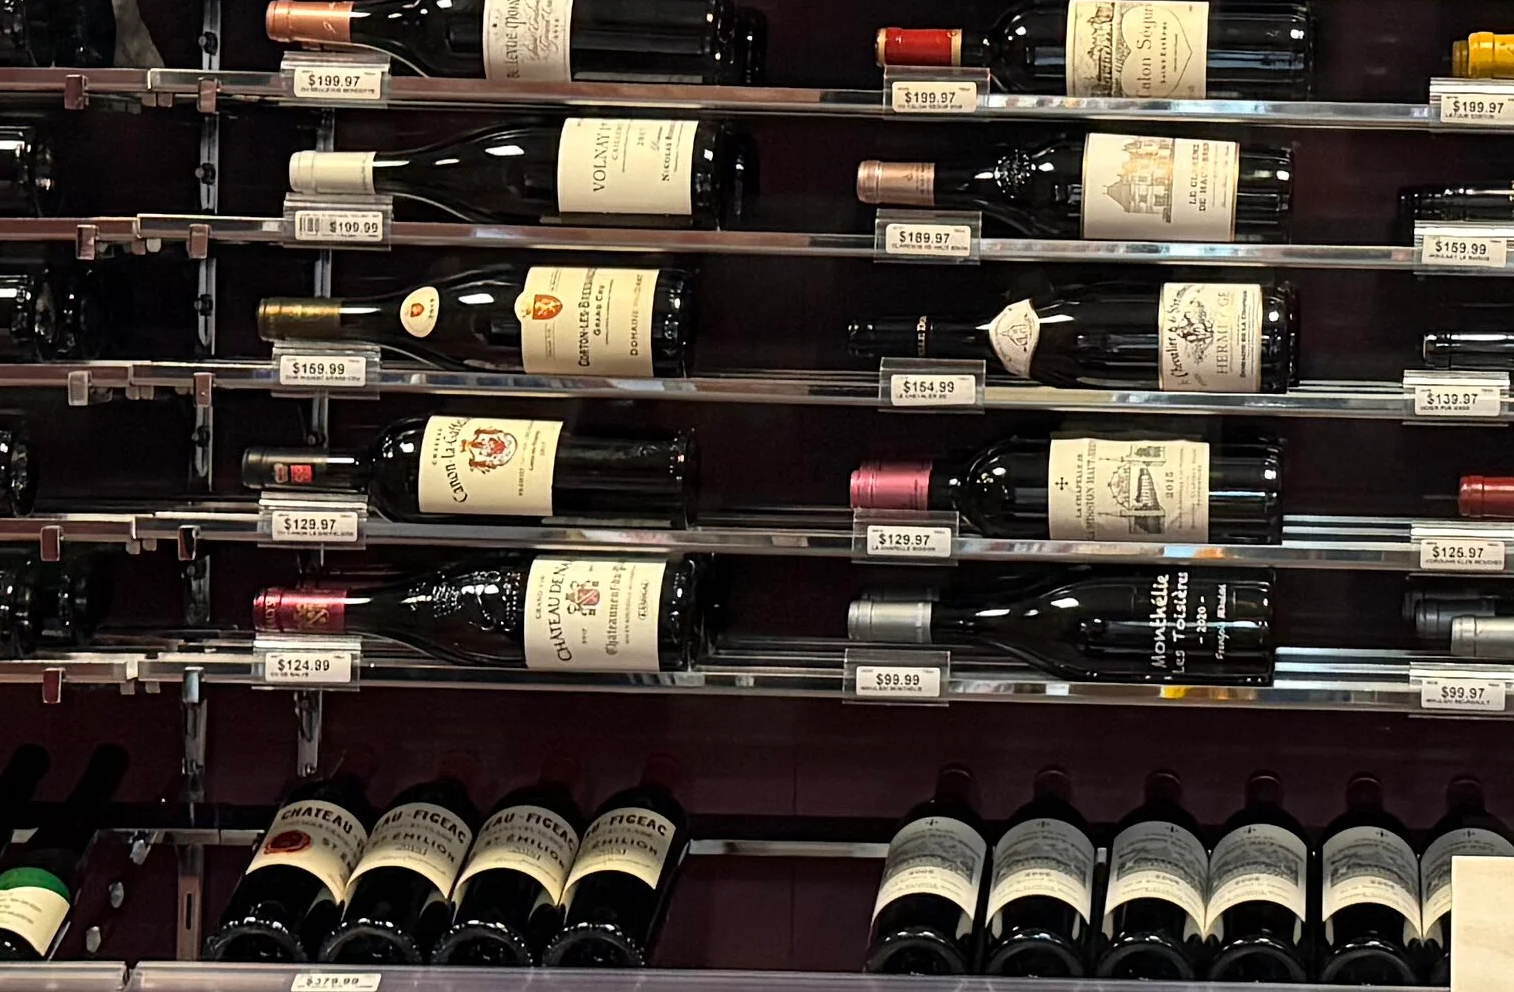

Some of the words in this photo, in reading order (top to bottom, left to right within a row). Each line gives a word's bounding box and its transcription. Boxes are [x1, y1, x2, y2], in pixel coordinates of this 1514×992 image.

[308, 74, 360, 87] $199.97
[904, 91, 956, 104] $199.97
[1452, 100, 1504, 113] $199.97
[592, 133, 608, 191] VOLNAY
[594, 307, 604, 336] GRAND
[1426, 392, 1478, 405] $139.97
[284, 517, 336, 531] $129.97
[878, 533, 930, 546] $129.97
[548, 578, 562, 595] DE
[1172, 571, 1189, 642] Toisières
[1149, 573, 1170, 669] Monthélie
[1196, 606, 1207, 633] 2020
[277, 658, 330, 672] $124.99
[1171, 650, 1187, 673] Les
[876, 673, 920, 686] $99.99
[1441, 686, 1485, 699] $99.97
[280, 807, 354, 835] CHATEAU
